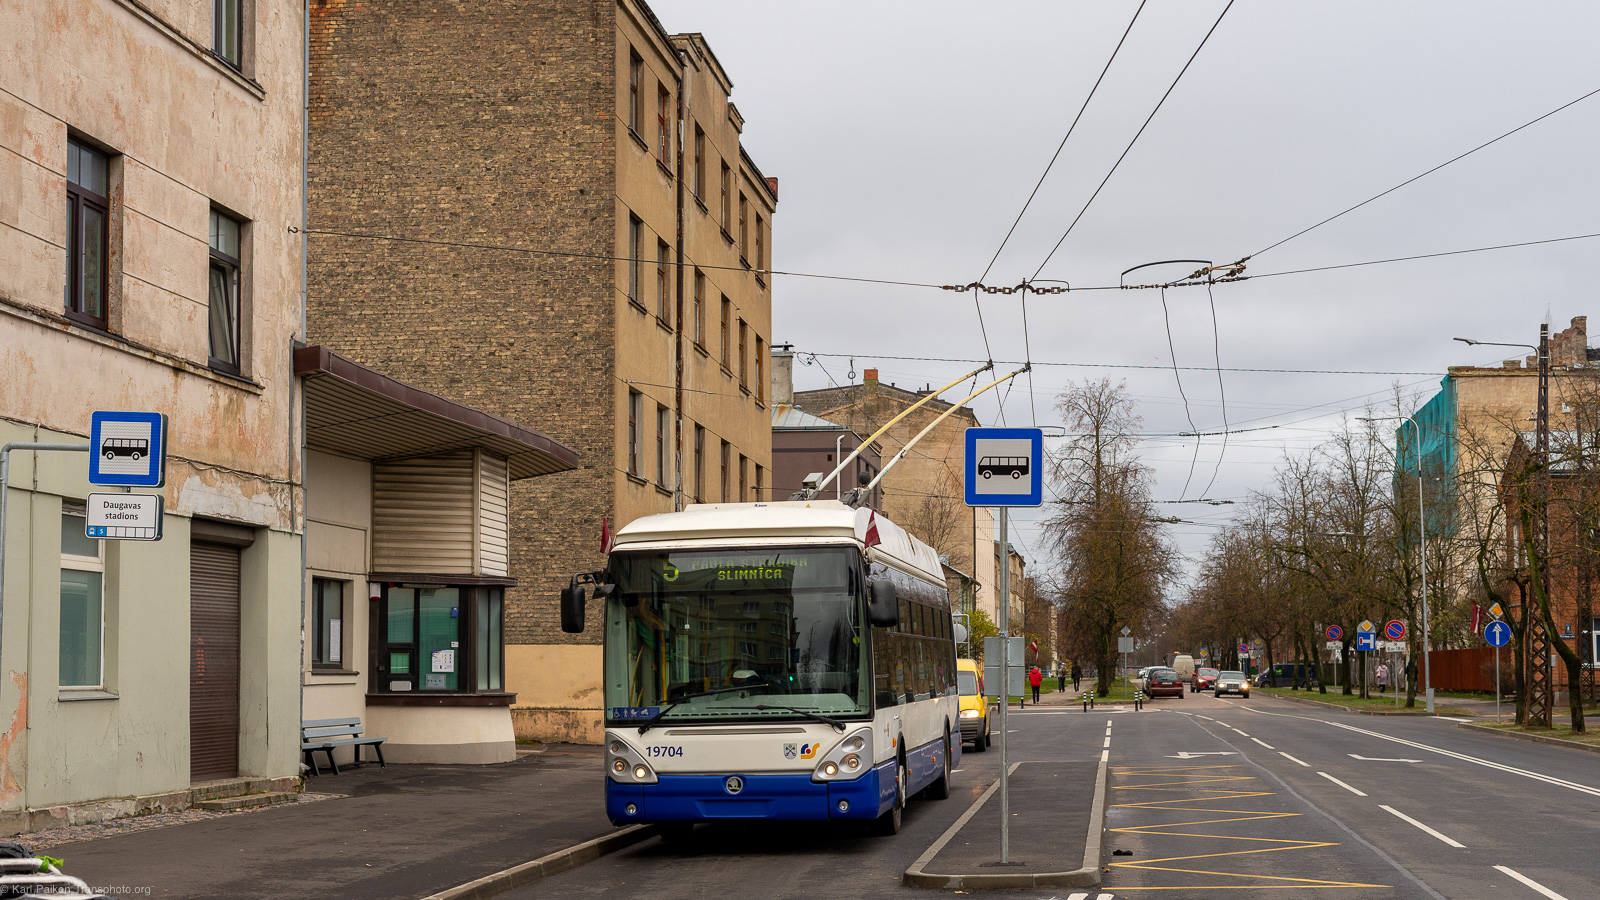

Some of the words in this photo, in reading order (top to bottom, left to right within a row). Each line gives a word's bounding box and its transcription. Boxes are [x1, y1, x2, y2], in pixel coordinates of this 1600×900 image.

[103, 501, 141, 510] Daugavas
[105, 512, 139, 520] stadions
[692, 559, 735, 570] PAULA
[663, 560, 679, 582] 5
[718, 567, 782, 581] SLIMNĪCA
[645, 746, 684, 757] 19704
